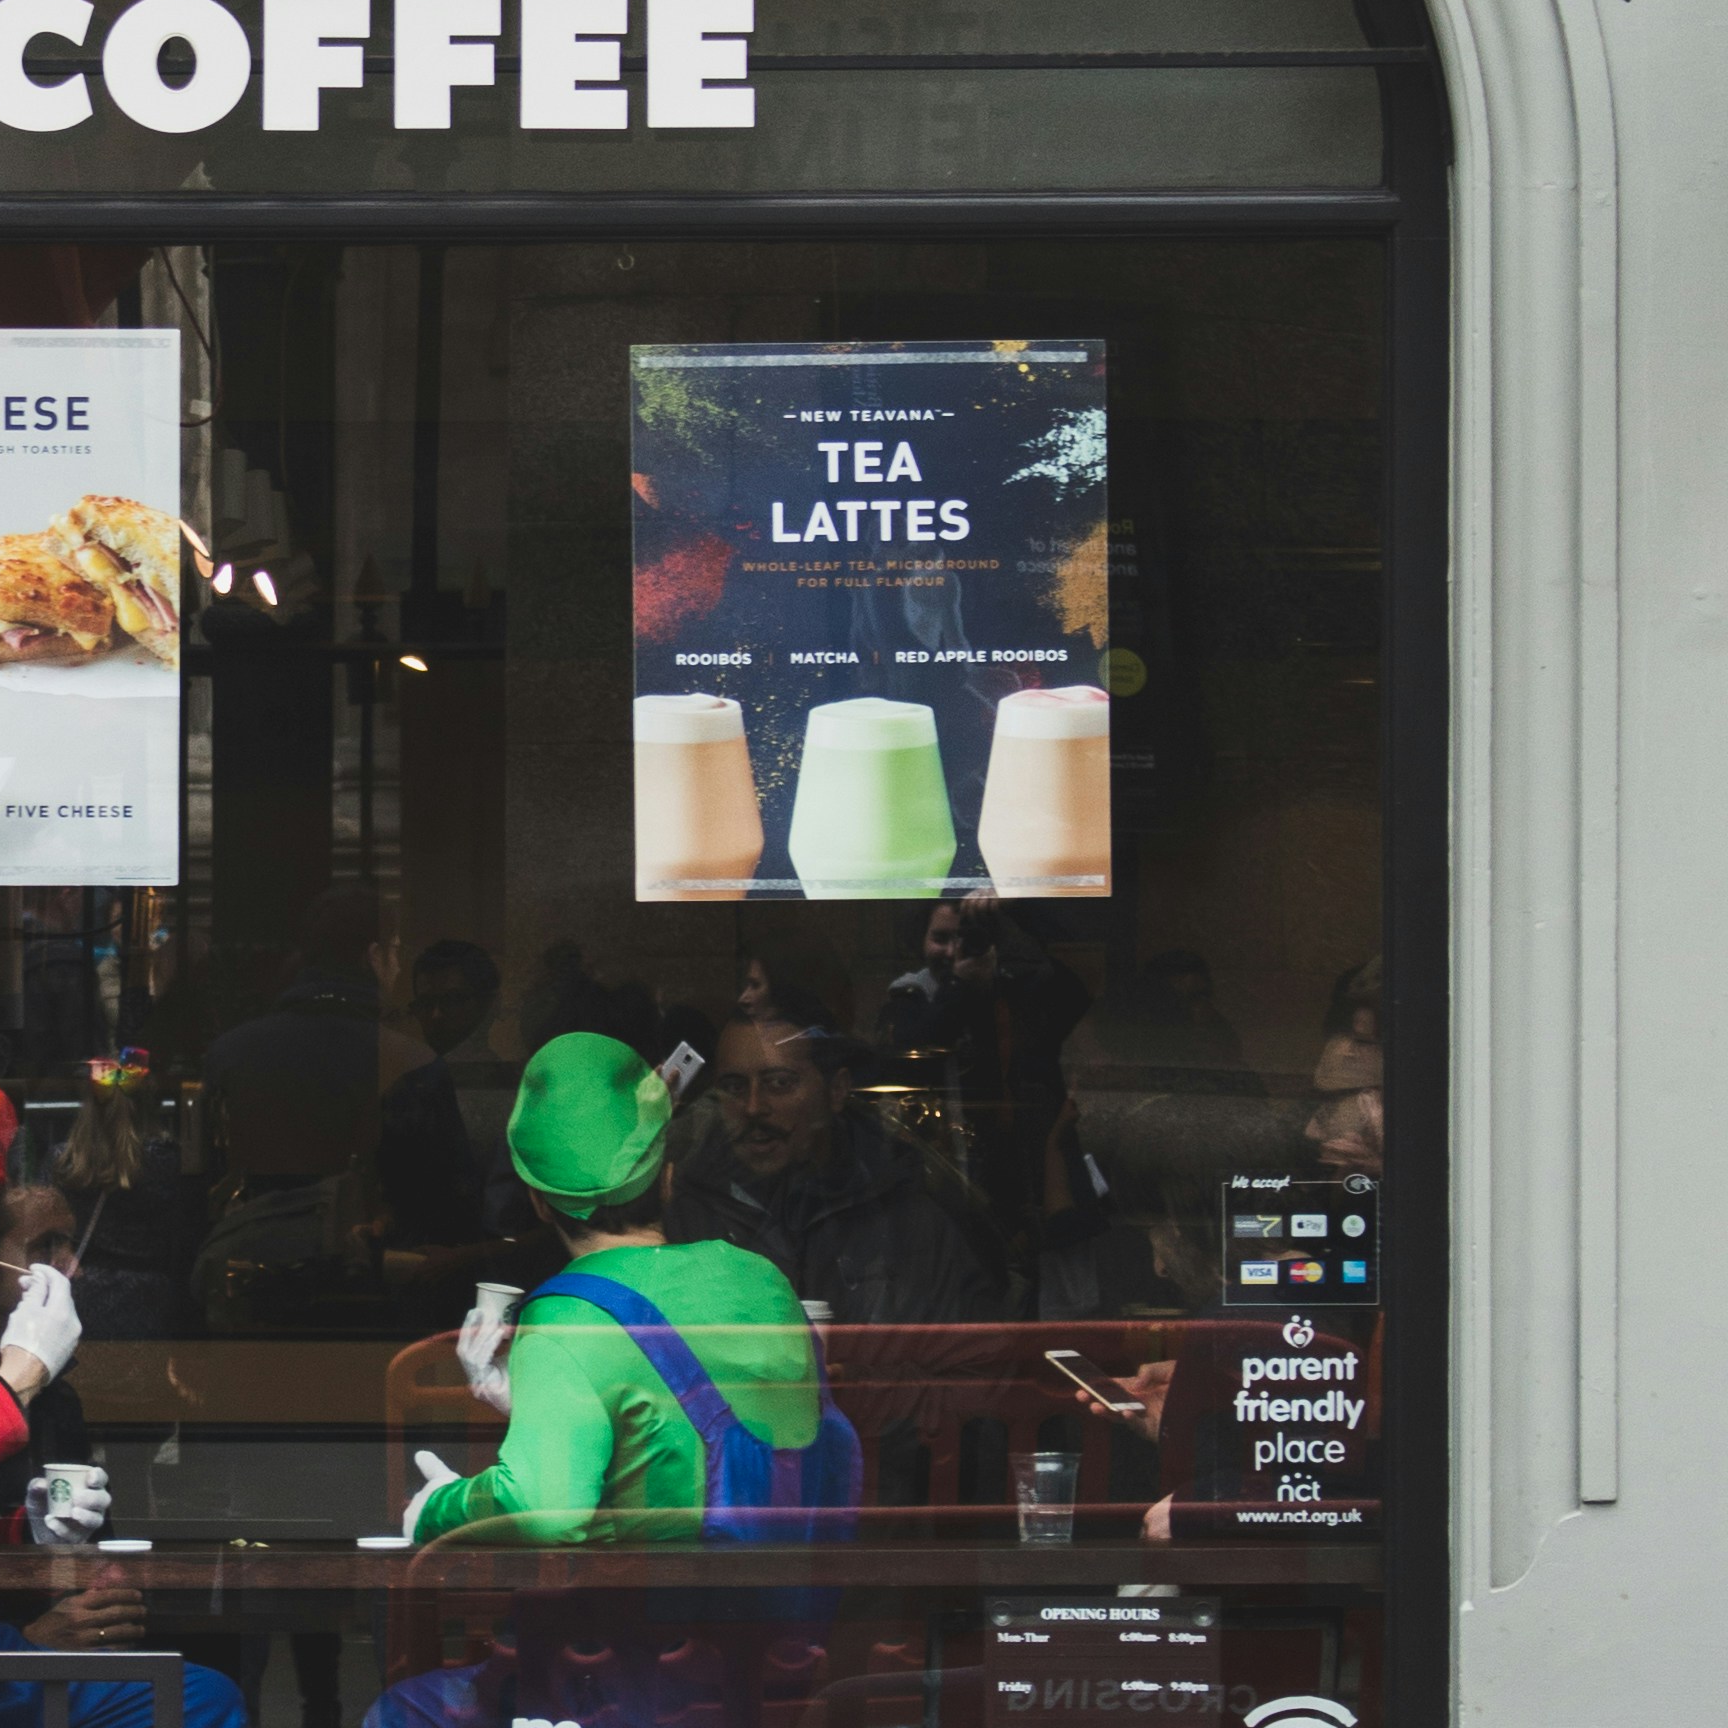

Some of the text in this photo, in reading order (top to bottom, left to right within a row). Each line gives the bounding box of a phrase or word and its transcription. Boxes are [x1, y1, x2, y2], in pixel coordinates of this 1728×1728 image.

[800, 410, 842, 423] NEW
[21, 444, 92, 455] TOASTIES
[817, 441, 923, 483] TEA
[771, 499, 970, 543] LATTES
[742, 560, 842, 572] WHOLE-LEAF
[886, 558, 1001, 570] MICROGROUND
[797, 576, 945, 588] FOR FULL FLAVOUR
[675, 652, 752, 666] ROOIBOS
[790, 651, 860, 665] MATCHA
[895, 649, 1068, 663] RED APPLE ROOIBOS
[5, 805, 133, 818] FIVE CHEESE
[1231, 1175, 1291, 1192] We accept
[1247, 1268, 1272, 1277] VISA
[1242, 1352, 1359, 1388] parent
[1232, 1390, 1365, 1430] friendly
[1255, 1431, 1346, 1471] place
[1277, 1480, 1321, 1503] nct
[1236, 1508, 1362, 1527] www.nct.org.uk
[1040, 1607, 1161, 1621] OPENING HOURS
[997, 1632, 1051, 1643] Mon-Thur
[998, 1681, 1033, 1694] Friday
